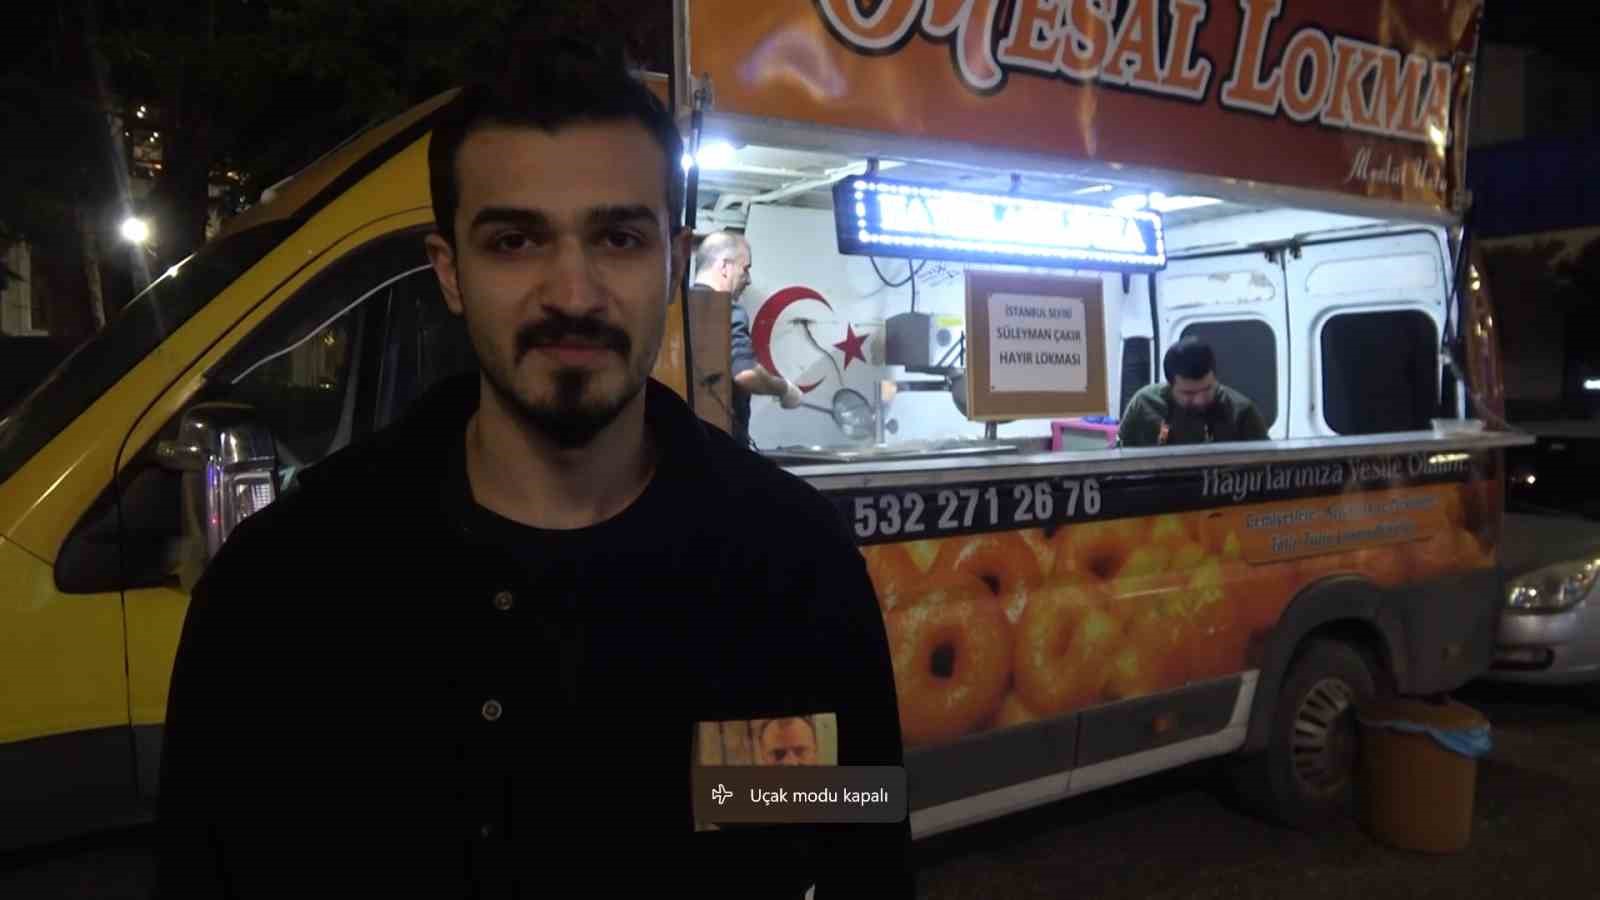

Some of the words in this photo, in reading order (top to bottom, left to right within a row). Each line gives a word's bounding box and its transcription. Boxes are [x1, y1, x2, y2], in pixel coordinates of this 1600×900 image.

[1221, 0, 1452, 146] LOKMA
[997, 325, 1052, 341] SÜLEYMAN
[1053, 329, 1081, 343] ÇAKIR
[1000, 351, 1033, 366] HAYIR
[1035, 351, 1081, 366] LOKMASI
[1201, 464, 1343, 502] Hayırlarınıza
[854, 492, 925, 537] 532
[938, 487, 999, 529] 271
[1013, 482, 1053, 521] 26
[1063, 478, 1101, 516] 76
